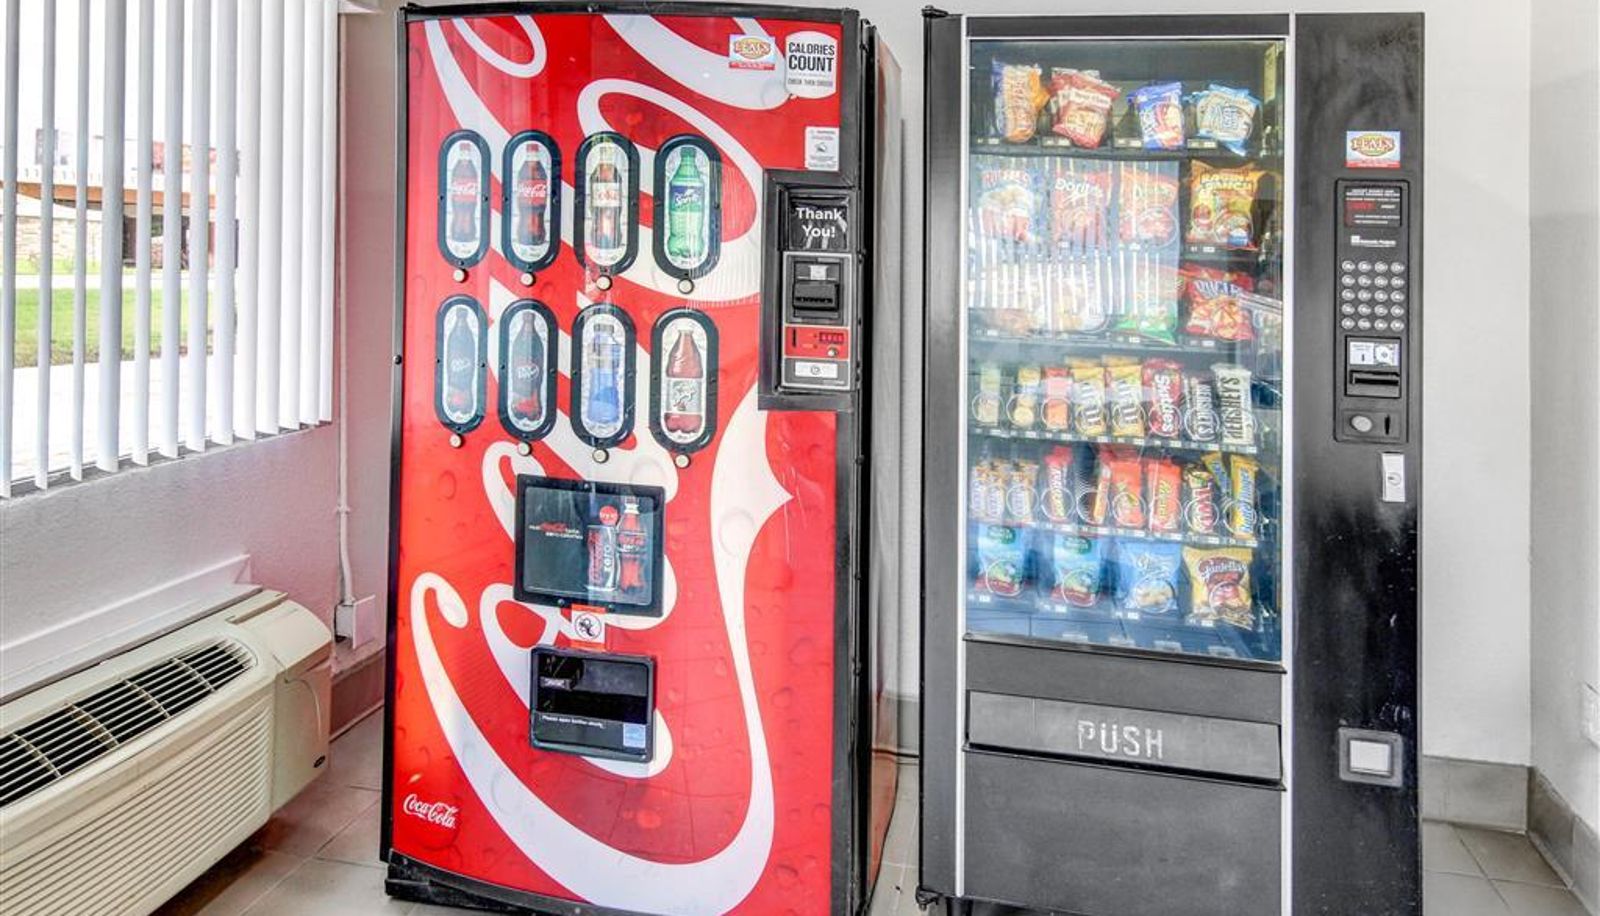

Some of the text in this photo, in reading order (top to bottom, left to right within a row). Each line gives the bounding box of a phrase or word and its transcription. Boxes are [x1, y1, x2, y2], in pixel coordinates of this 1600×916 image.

[788, 41, 835, 56] CALORIES
[788, 54, 835, 73] COUNT
[795, 207, 843, 221] Thank
[801, 224, 836, 239] You!
[1154, 373, 1175, 433] Skittles
[1221, 376, 1244, 440] HERSHEY'S
[1077, 720, 1163, 759] PUSH
[403, 793, 458, 829] Coca-Cola
